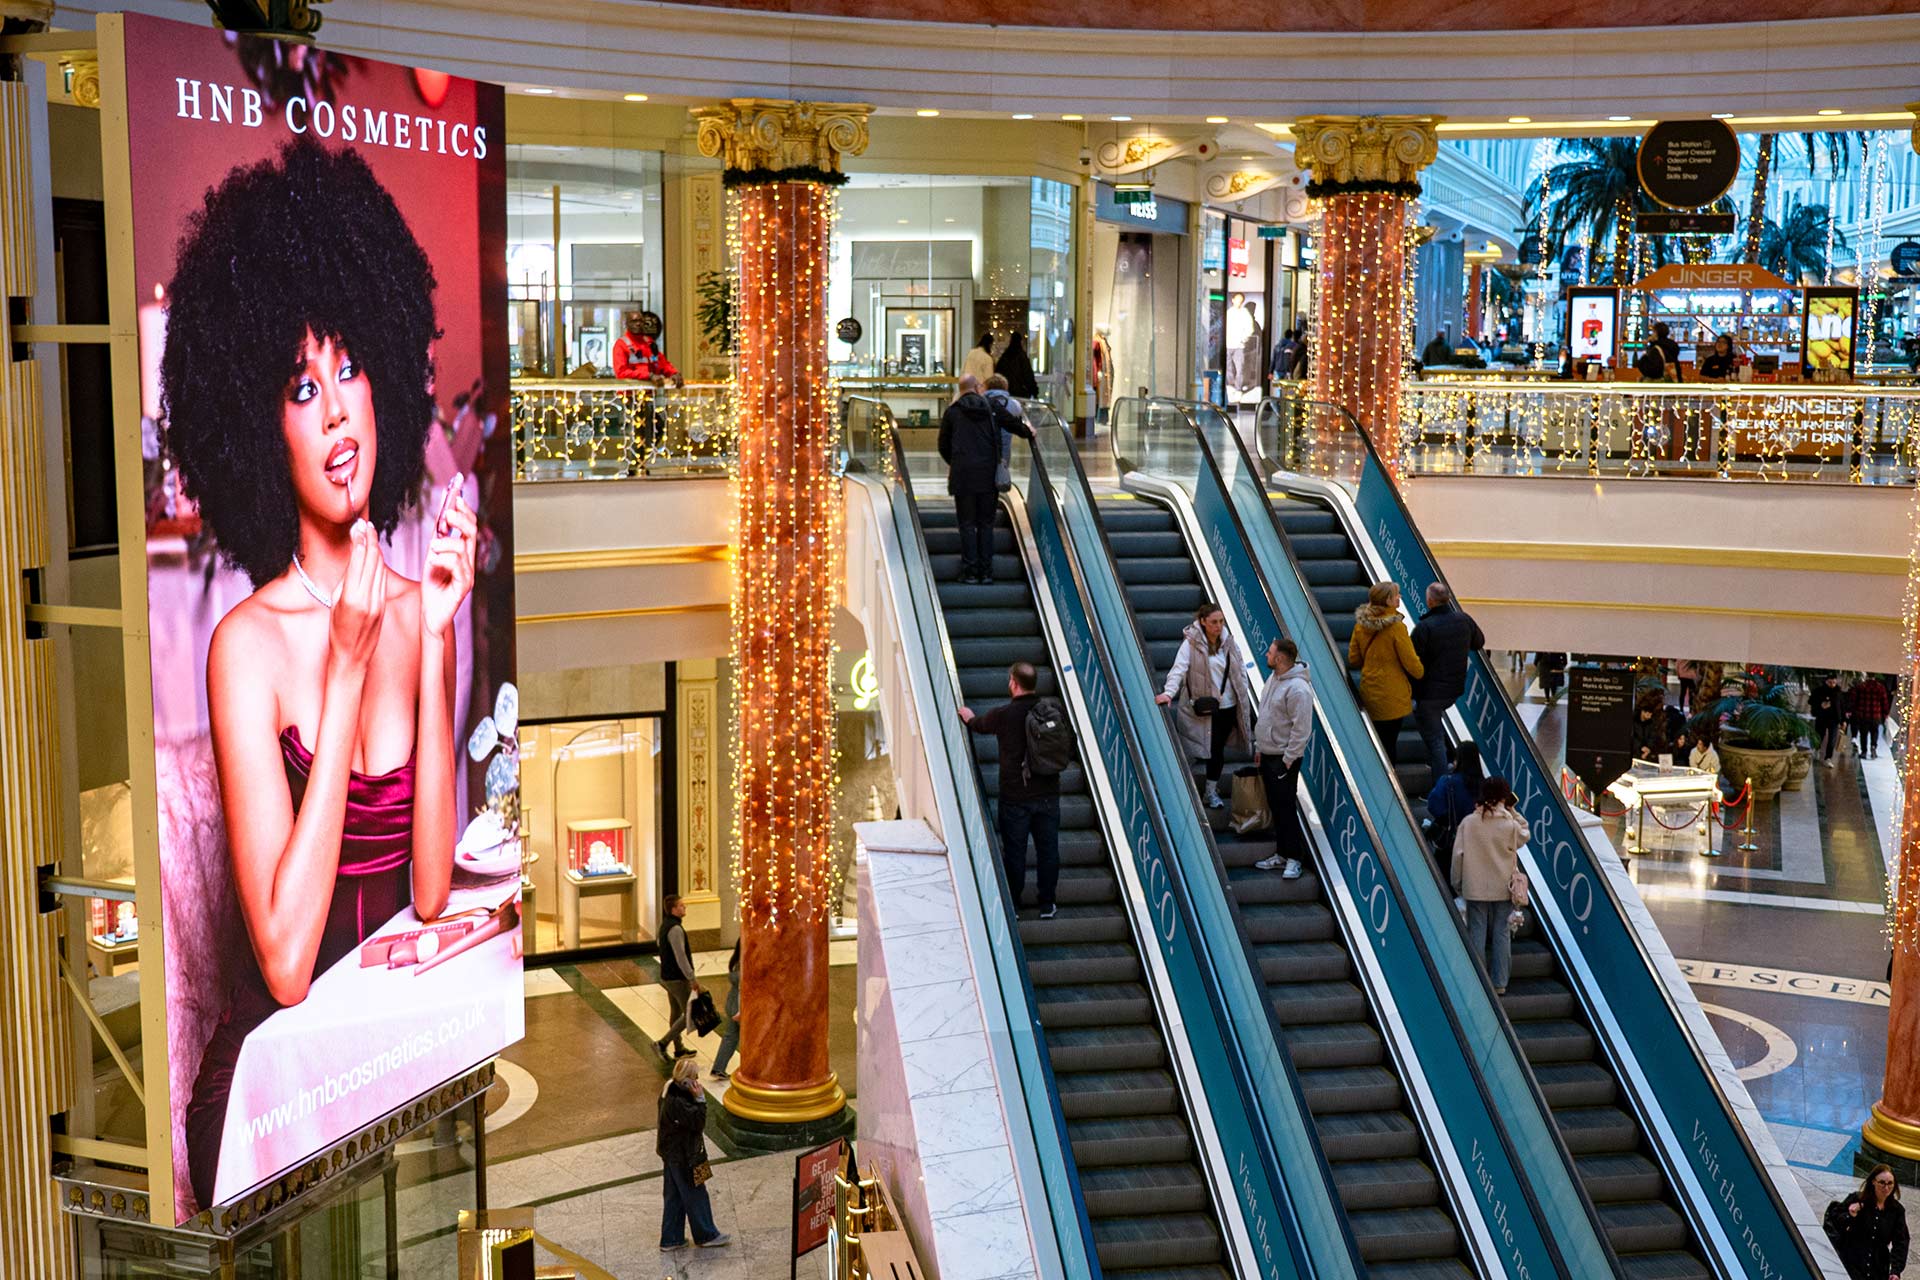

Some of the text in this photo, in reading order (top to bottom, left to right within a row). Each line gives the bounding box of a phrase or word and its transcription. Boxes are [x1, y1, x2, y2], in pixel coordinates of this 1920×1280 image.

[175, 77, 488, 160] HNB COSMETICS
[1669, 267, 1753, 286] JINGER
[1213, 524, 1228, 567] With
[1237, 584, 1253, 626] Since
[1251, 620, 1268, 656] 1837
[1379, 518, 1427, 617] With love, Since
[1084, 638, 1143, 835] TIFFANY
[238, 1001, 487, 1147] www.hnbcosmetics.co.uk
[812, 1159, 827, 1176] GET
[1240, 1151, 1272, 1263] Visit the
[1471, 1138, 1531, 1280] Visit the ne
[1692, 1118, 1774, 1280] Visit the new
